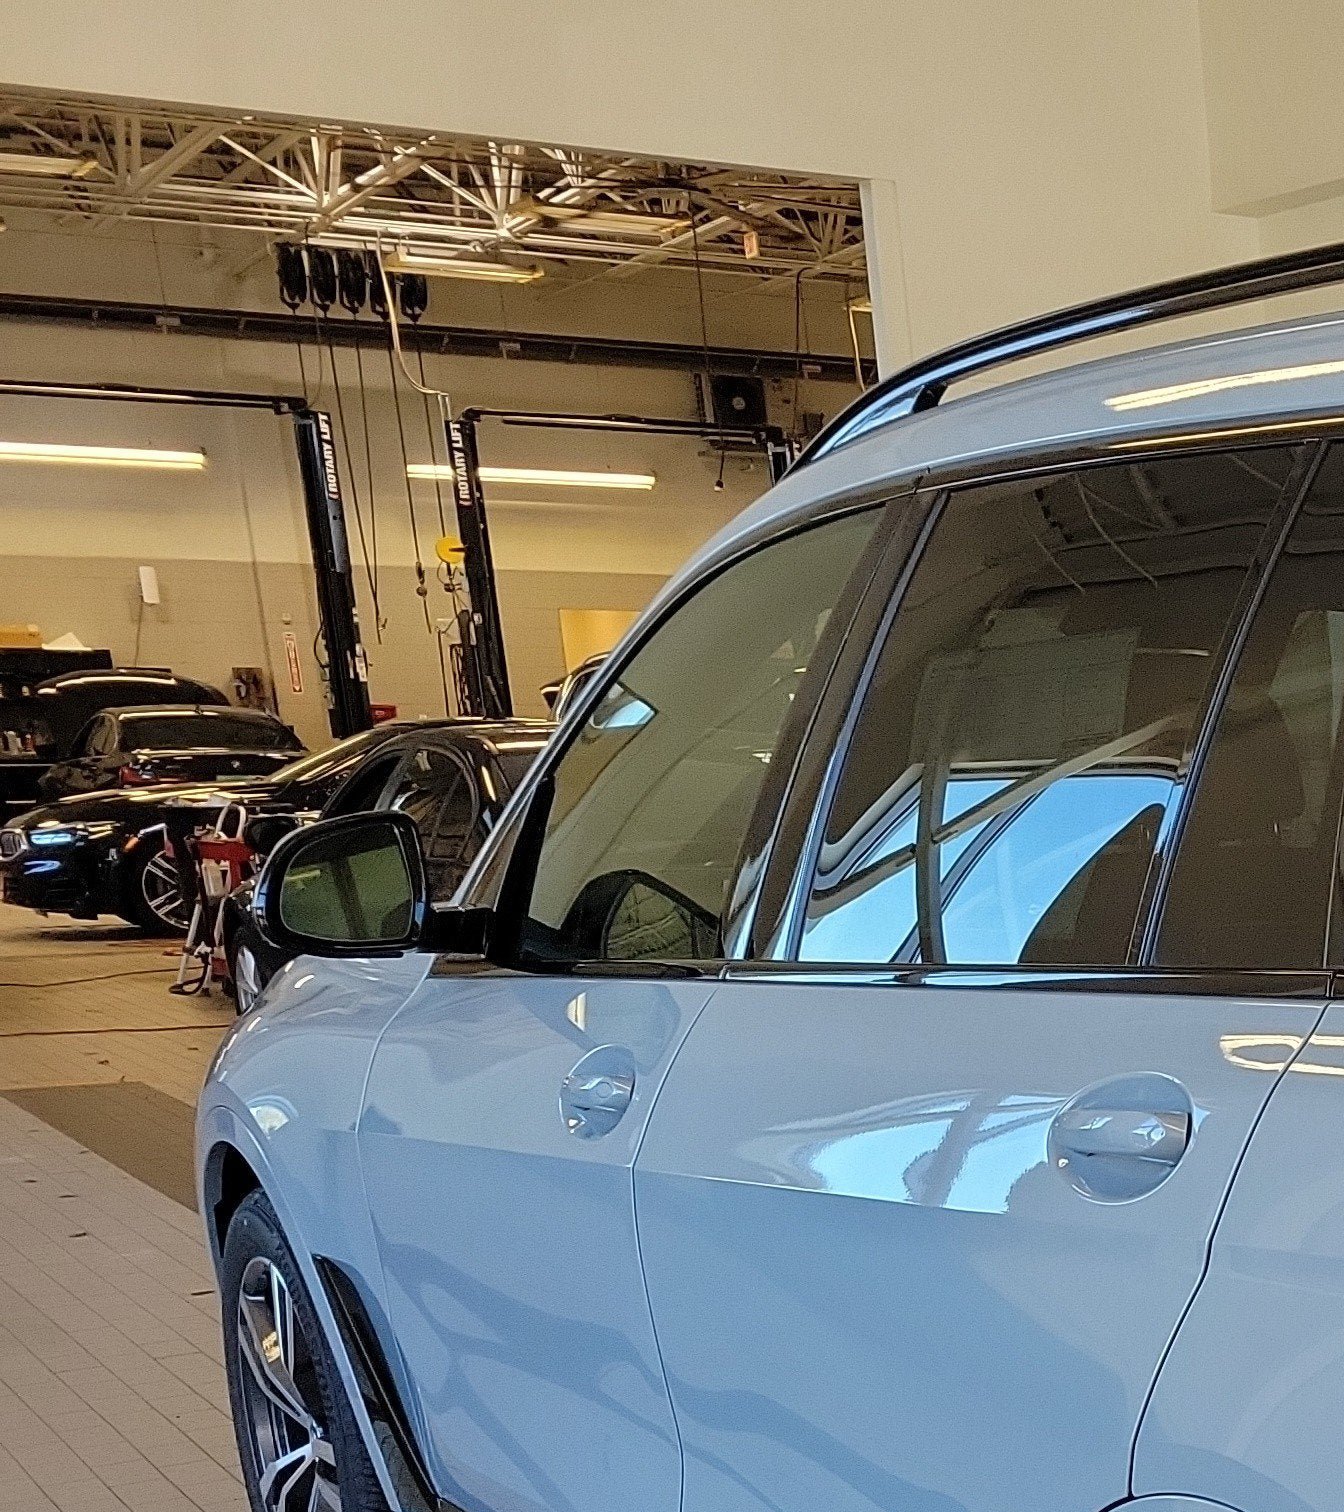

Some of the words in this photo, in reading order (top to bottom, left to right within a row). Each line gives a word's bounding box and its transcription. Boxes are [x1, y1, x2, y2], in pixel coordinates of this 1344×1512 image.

[318, 412, 331, 441] LIFT
[449, 422, 464, 448] LIFT
[322, 441, 339, 493] ROTARY
[453, 449, 471, 500] ROTARY
